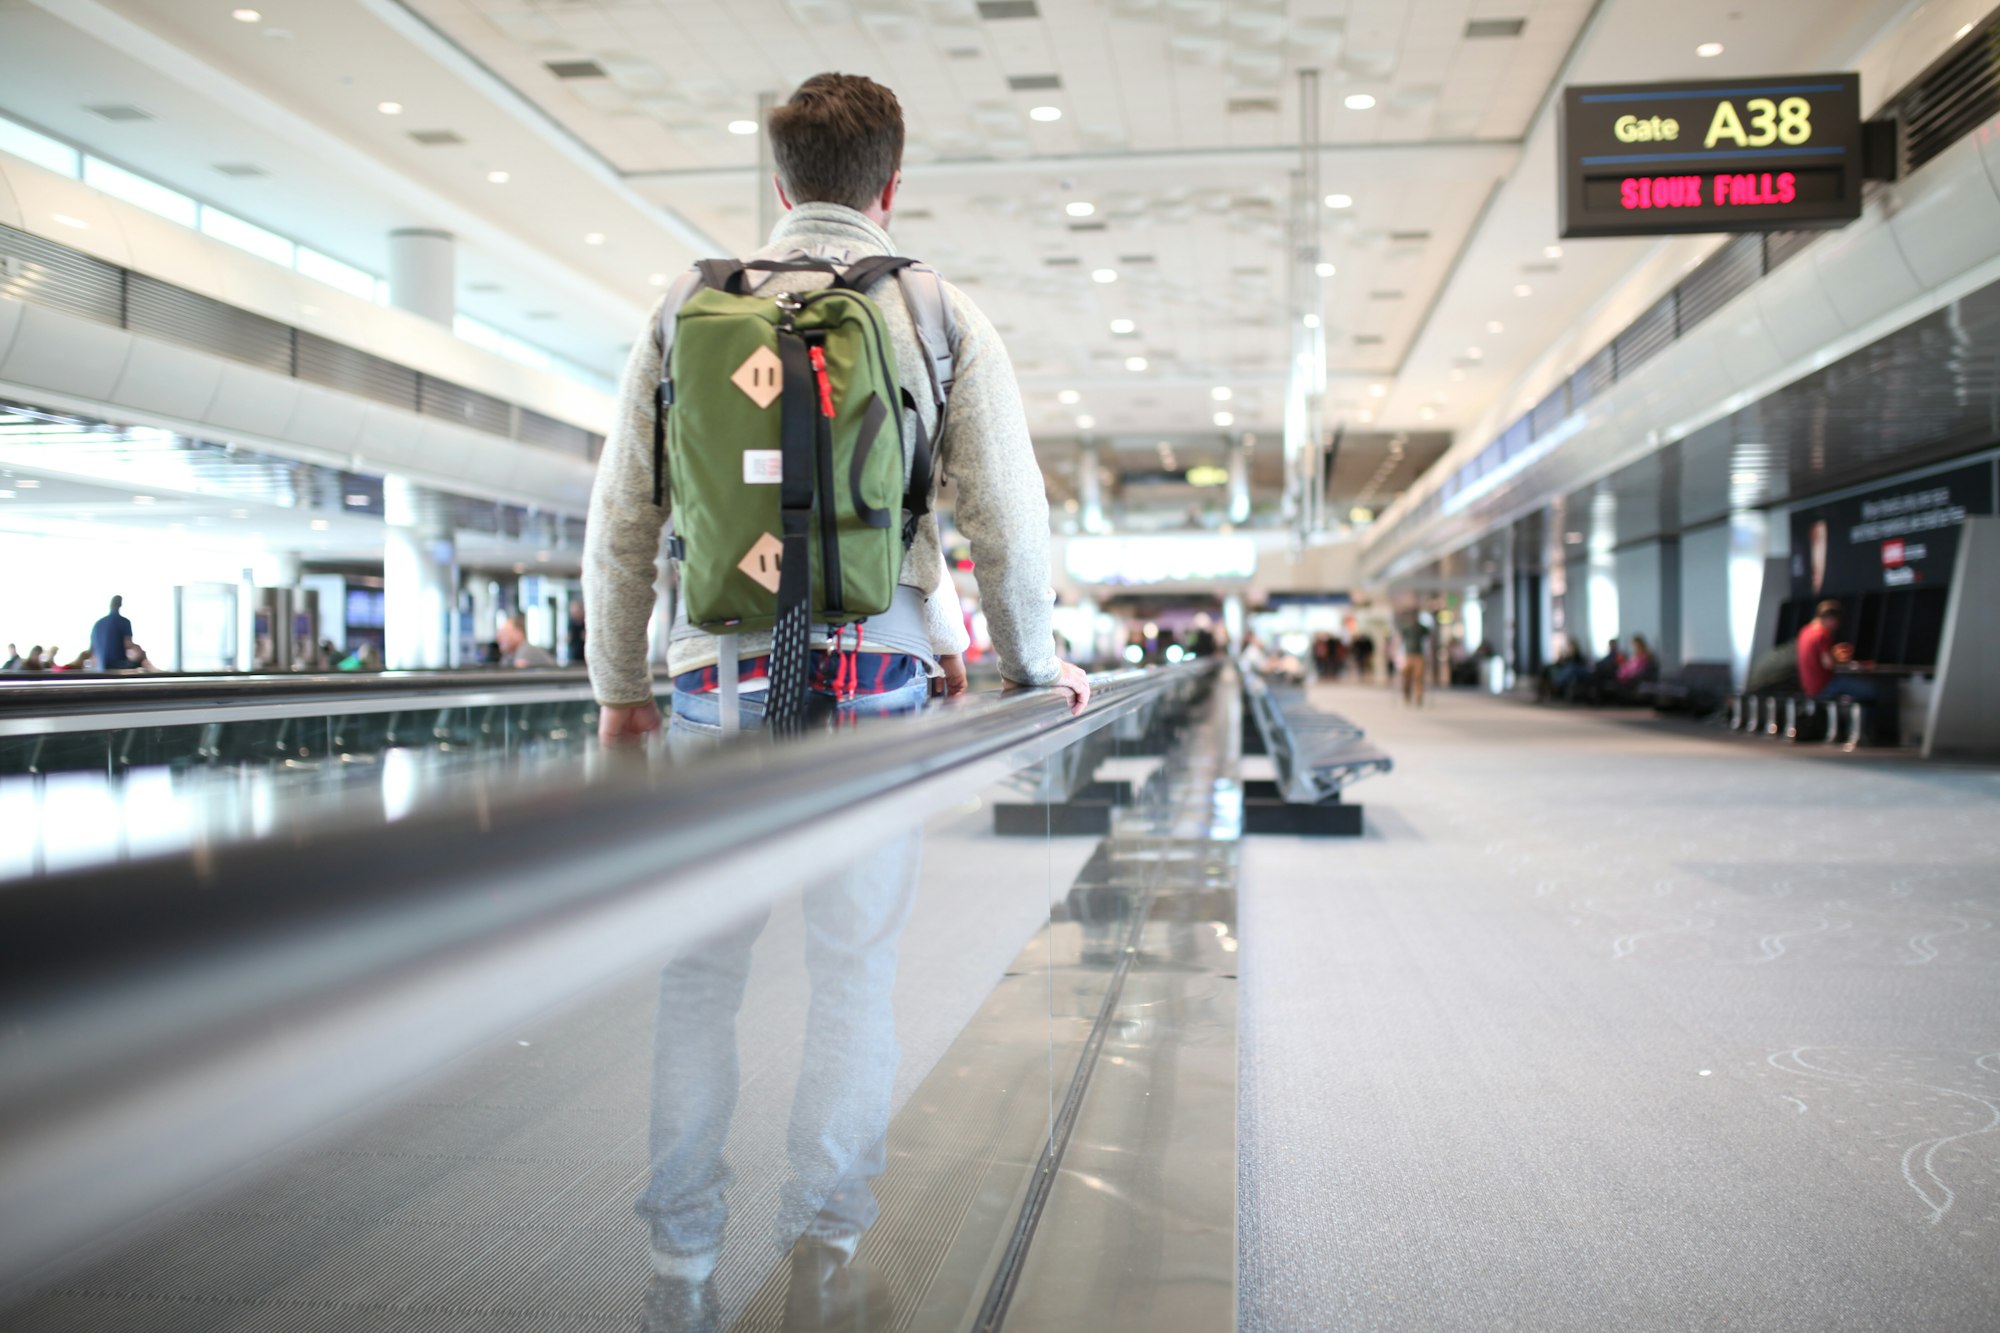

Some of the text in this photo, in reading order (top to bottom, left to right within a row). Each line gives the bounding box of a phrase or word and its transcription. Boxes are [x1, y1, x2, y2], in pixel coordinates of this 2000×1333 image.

[1614, 97, 1812, 148] Gate A38
[1620, 172, 1796, 209] SIOUX FALLS
